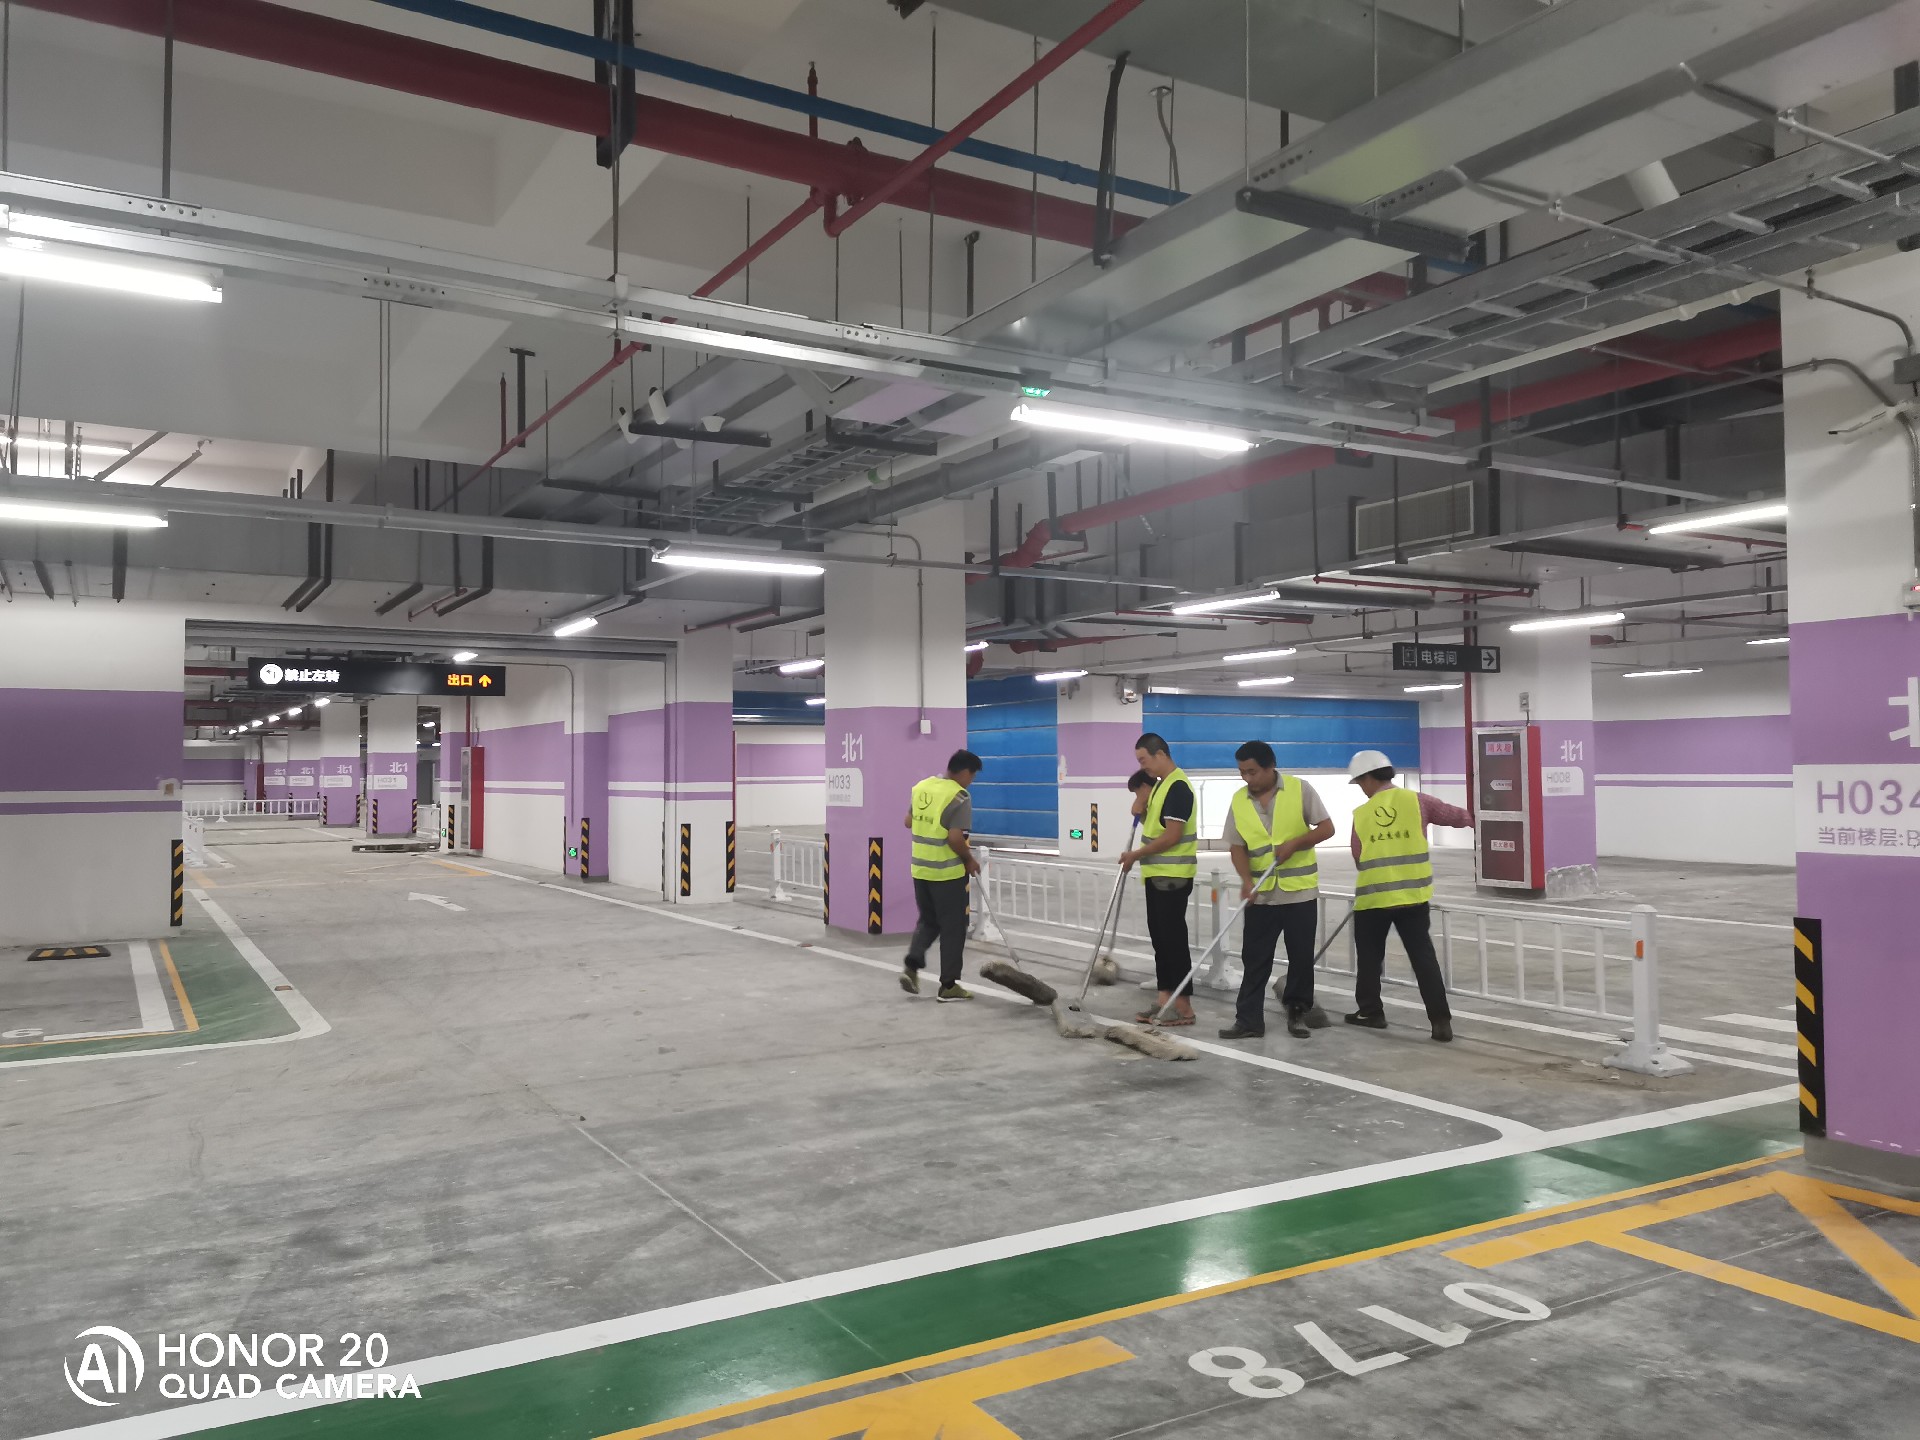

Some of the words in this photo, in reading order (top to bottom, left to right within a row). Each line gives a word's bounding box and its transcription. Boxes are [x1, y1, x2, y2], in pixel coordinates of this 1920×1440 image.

[1421, 650, 1457, 665] 电梯间
[284, 668, 340, 683] 禁止左转
[447, 673, 473, 687] 出口
[841, 732, 863, 763] 北1
[1560, 739, 1583, 762] 北1
[389, 761, 408, 774] 北1
[828, 774, 851, 790] H033
[1188, 1282, 1551, 1398] 0178
